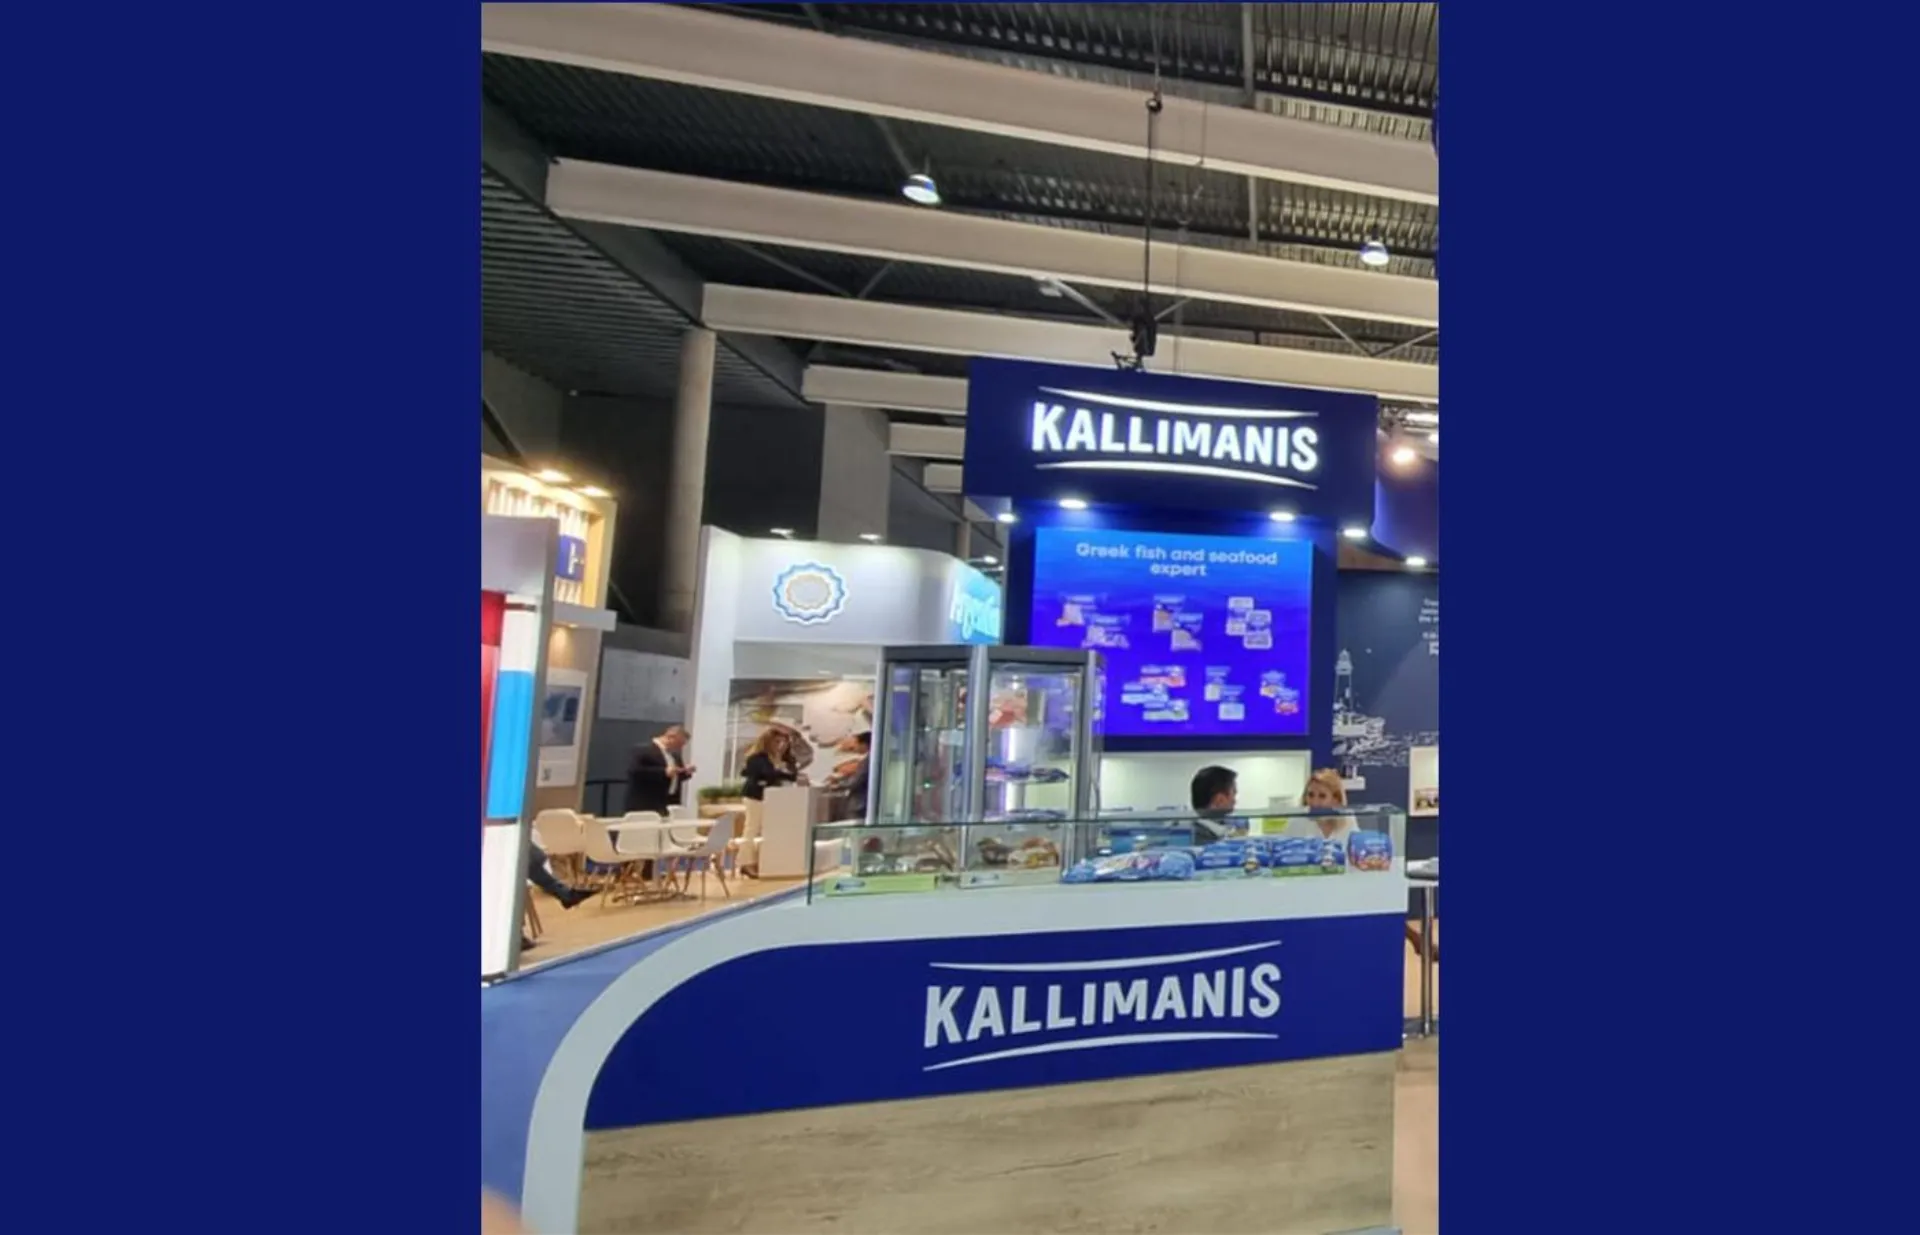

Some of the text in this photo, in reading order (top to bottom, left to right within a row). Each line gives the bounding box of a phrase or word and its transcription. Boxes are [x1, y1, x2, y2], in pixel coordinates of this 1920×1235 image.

[1031, 402, 1319, 472] KALLIMANIS
[1076, 542, 1278, 565] Greek fish and seafood
[1150, 562, 1207, 577] expert
[924, 963, 1282, 1048] KALLIMANIS
